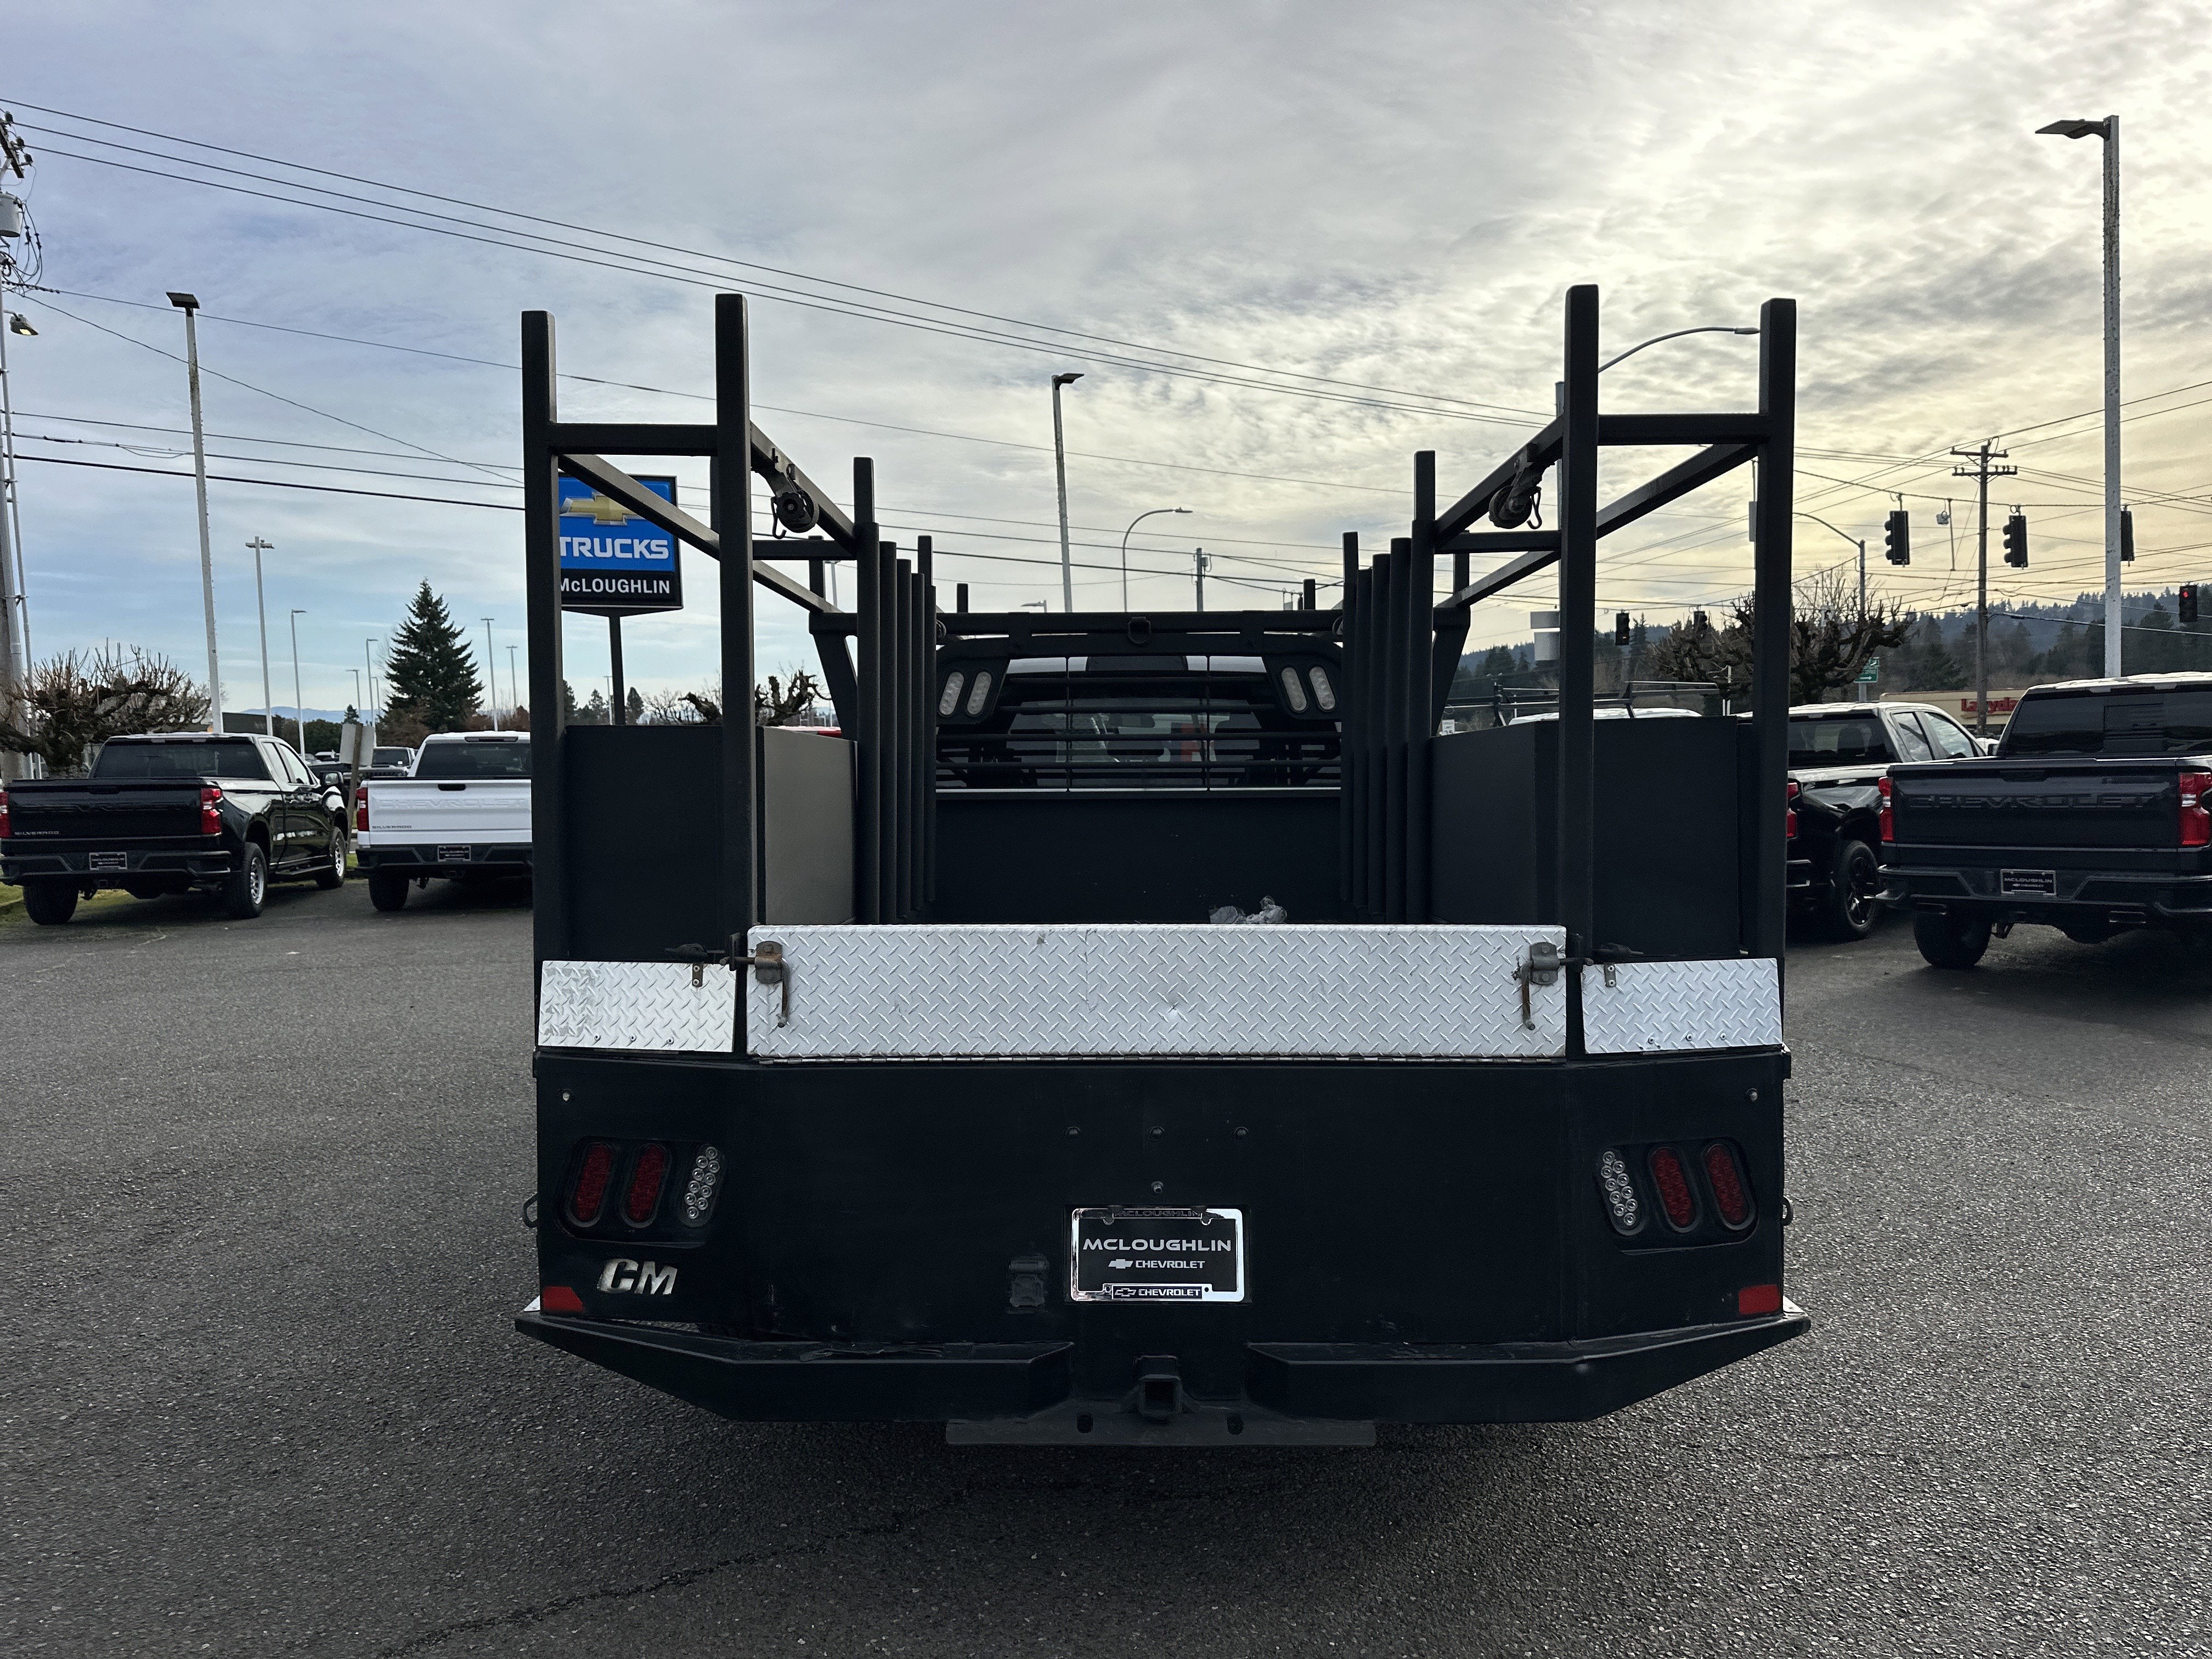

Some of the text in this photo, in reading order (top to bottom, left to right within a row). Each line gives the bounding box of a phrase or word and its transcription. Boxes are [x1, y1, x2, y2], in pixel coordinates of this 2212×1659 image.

[560, 536, 669, 560] TRUCKS
[561, 578, 670, 594] McLOUGHLIN
[379, 798, 525, 809] CHEVROLET
[1910, 793, 2154, 808] CHEVROLET
[1082, 1238, 1232, 1251] MCLOUGHLIN
[1135, 1260, 1205, 1268] CHEVROLET
[597, 1258, 678, 1295] CM
[1138, 1289, 1201, 1297] CHEVROLET
